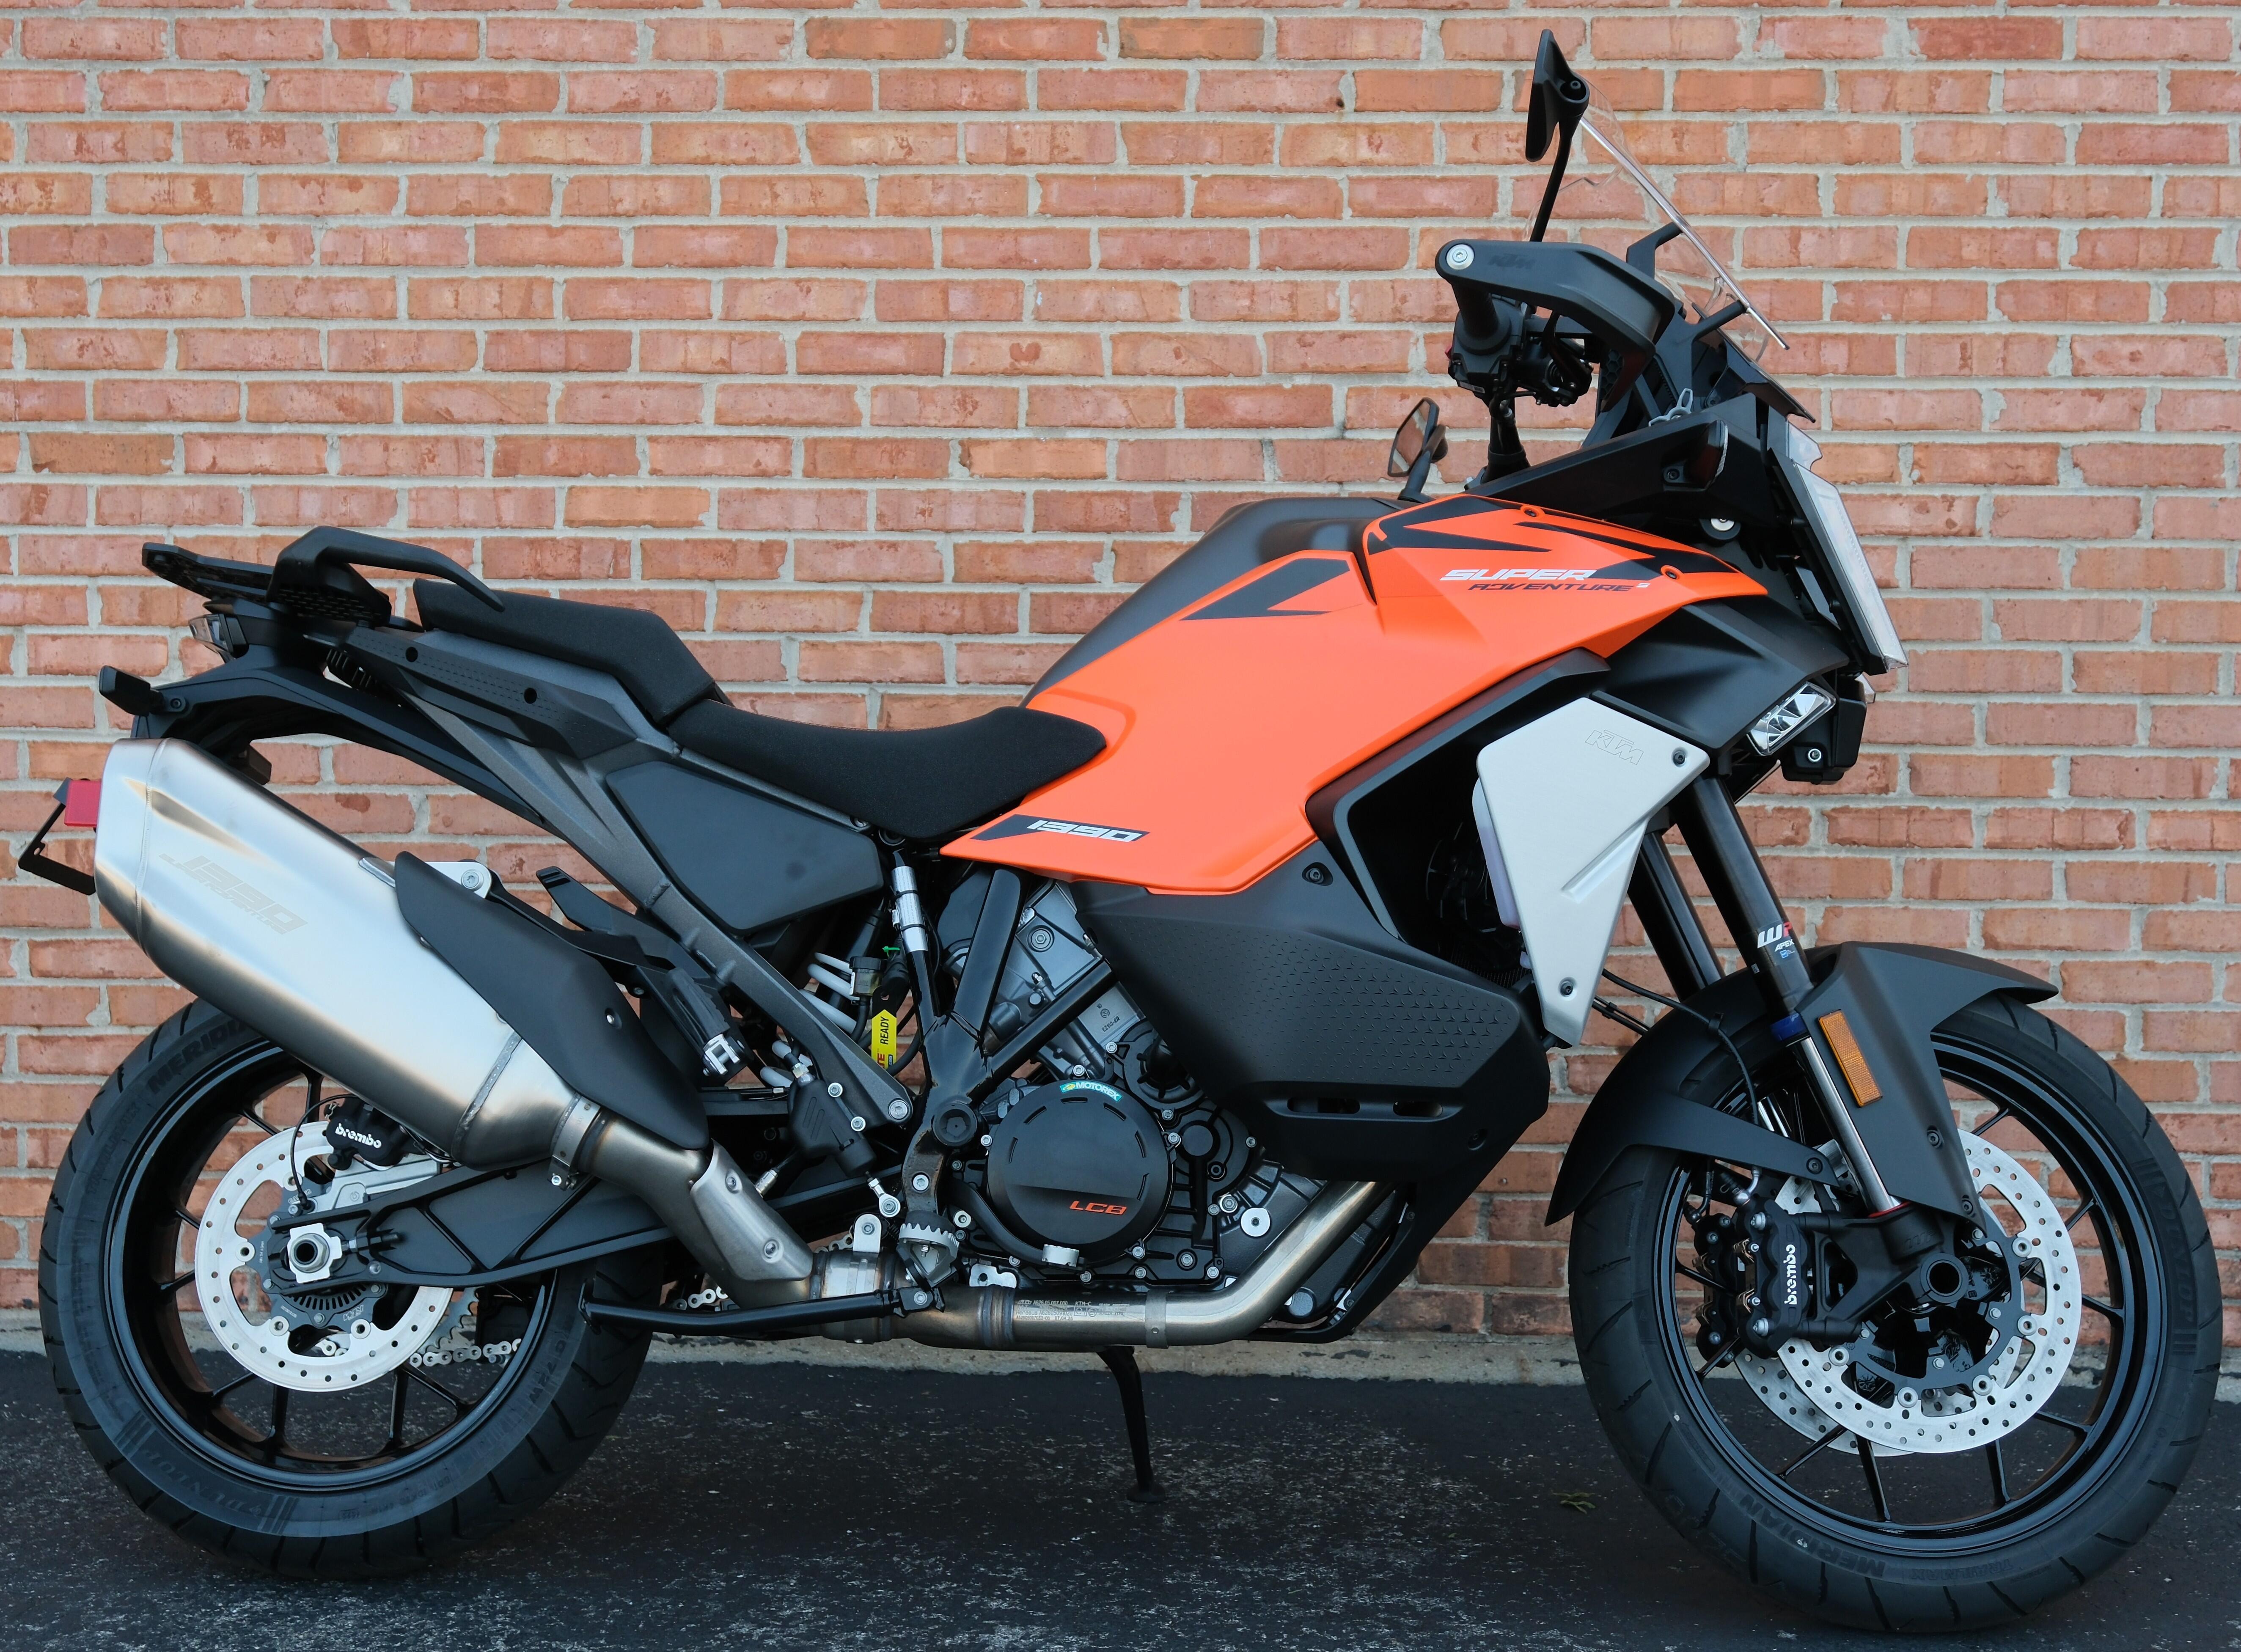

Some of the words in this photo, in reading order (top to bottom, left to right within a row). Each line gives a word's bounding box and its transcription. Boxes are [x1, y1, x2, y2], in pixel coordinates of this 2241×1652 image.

[1439, 569, 1597, 581] SUPER
[1468, 583, 1636, 592] ADVENTURE
[1585, 730, 1644, 765] KTM
[1027, 819, 1143, 843] 1390
[184, 855, 308, 932] 1390
[1757, 921, 1793, 949] WP
[1774, 939, 1795, 952] APEX
[880, 1016, 889, 1045] READY
[1076, 1081, 1119, 1101] MOTOREX
[335, 1123, 382, 1148] brembo
[1069, 1201, 1127, 1215] LC8
[1784, 1244, 1797, 1305] brembo
[2159, 1201, 2195, 1323] DUNLOP
[143, 1449, 248, 1513] DUNLOP
[1740, 1494, 1886, 1577] MERIDIAN
[1911, 1559, 2013, 1581] TRAILMAX
